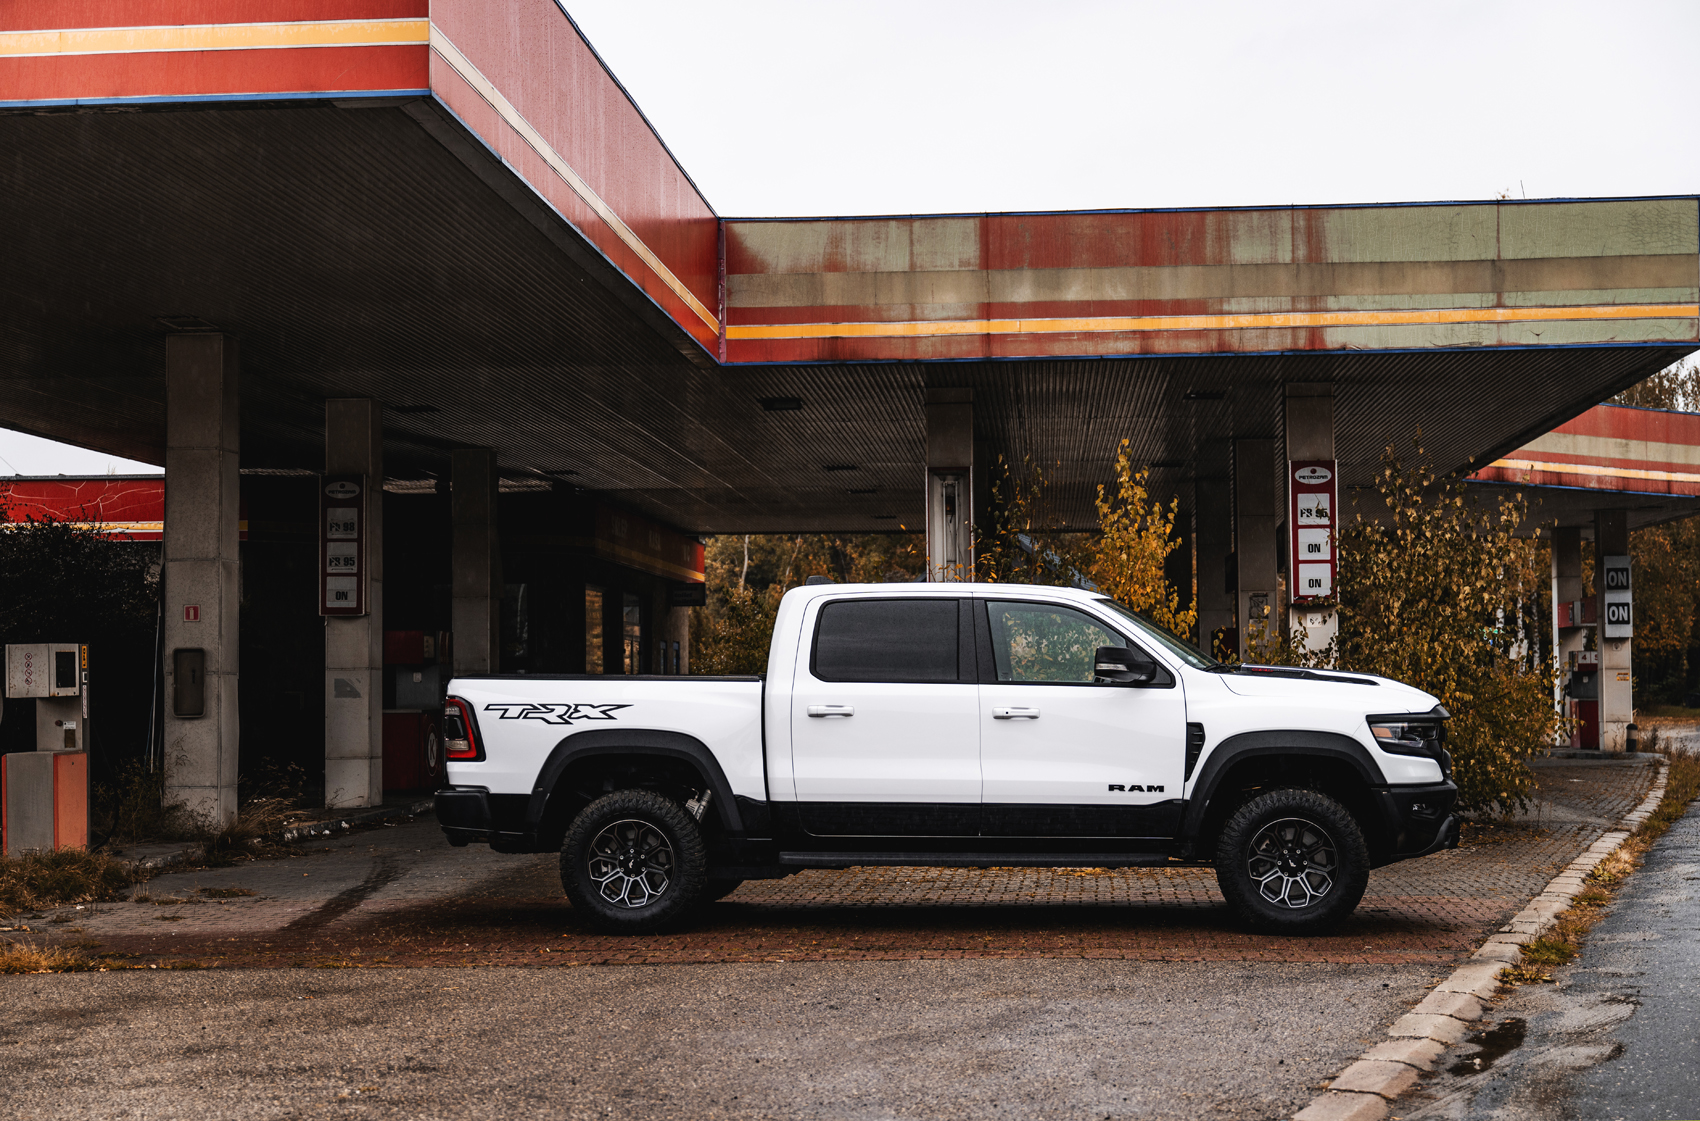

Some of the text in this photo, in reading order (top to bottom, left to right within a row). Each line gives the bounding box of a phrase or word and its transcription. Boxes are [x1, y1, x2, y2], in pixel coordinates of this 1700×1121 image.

[343, 522, 355, 532] 98
[1307, 543, 1321, 553] ON
[343, 557, 355, 566] 95
[1308, 578, 1321, 588] ON
[1607, 571, 1627, 587] ON
[335, 591, 348, 600] ON
[1608, 606, 1628, 622] ON
[483, 703, 635, 725] TRX
[429, 738, 436, 760] K
[1108, 784, 1165, 793] RAM
